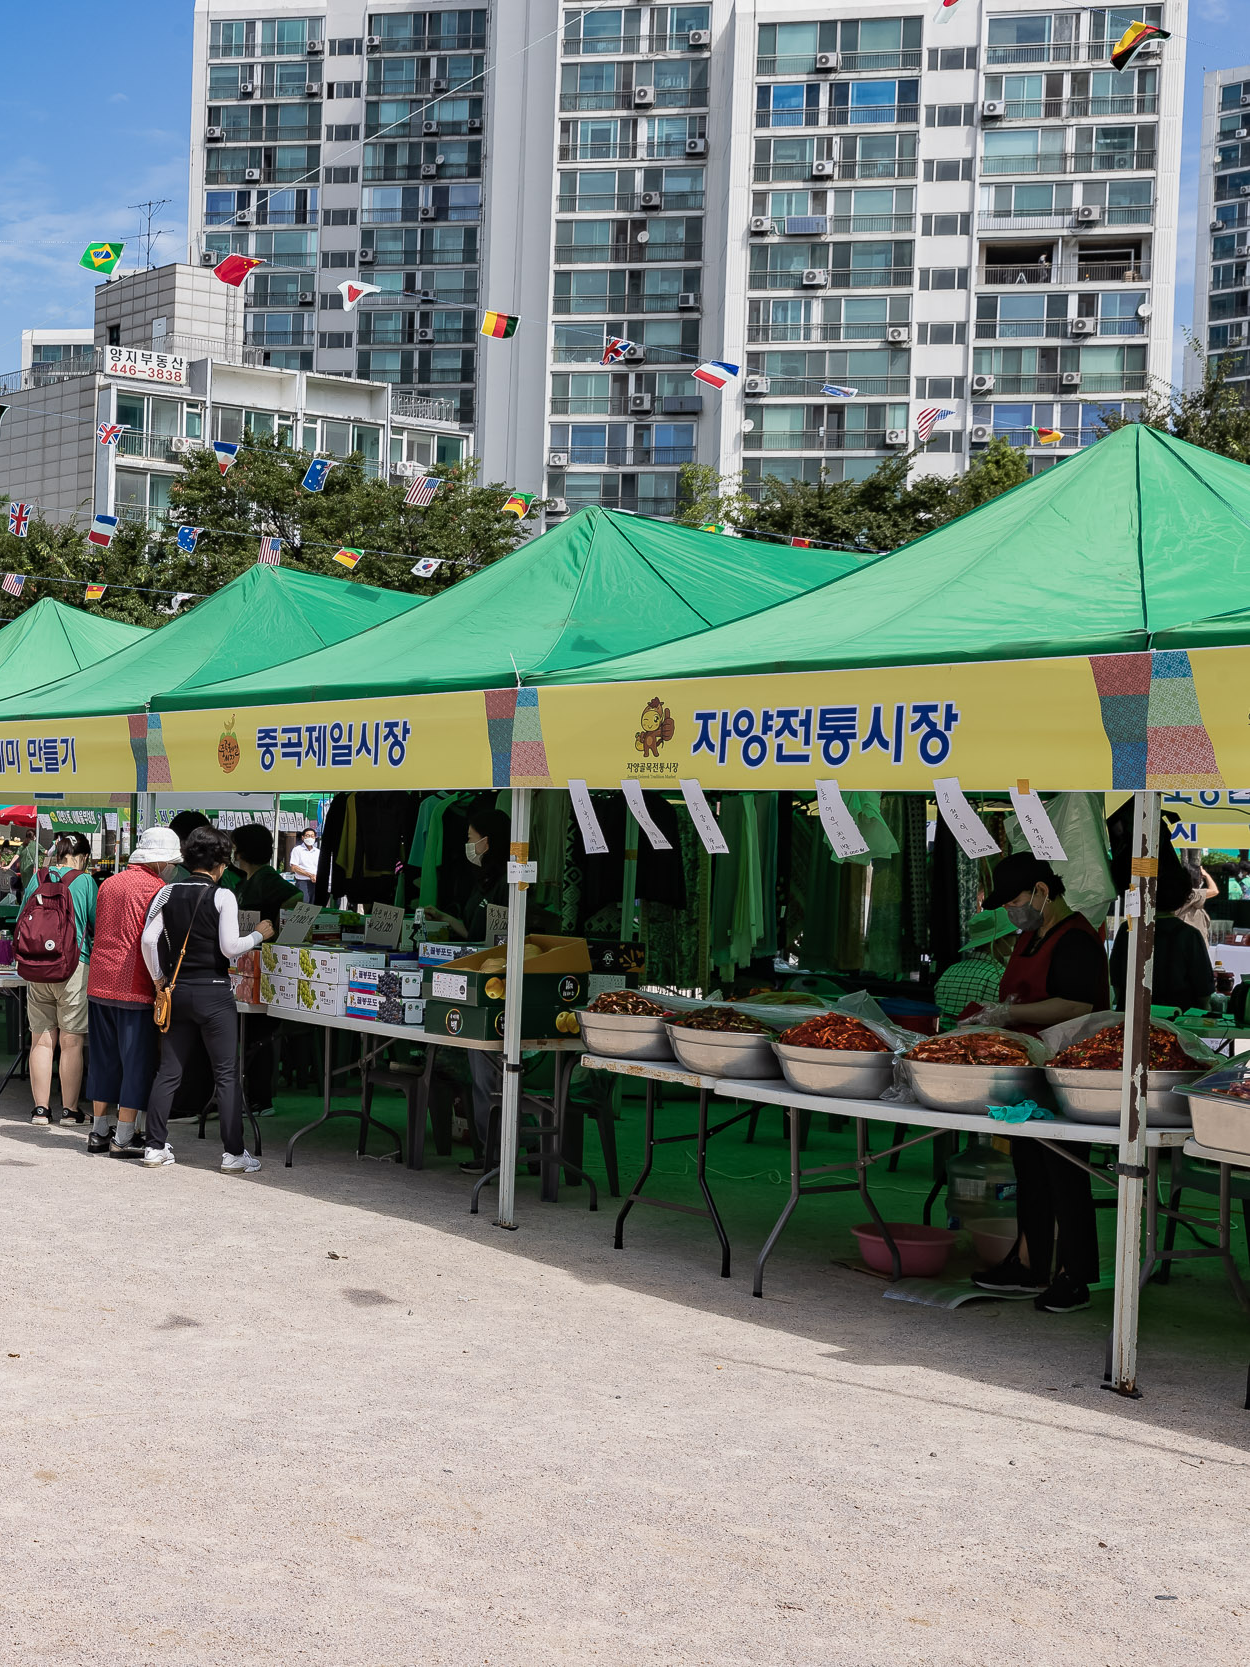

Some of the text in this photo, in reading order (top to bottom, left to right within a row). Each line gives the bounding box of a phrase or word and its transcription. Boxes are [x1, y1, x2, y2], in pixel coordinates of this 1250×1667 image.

[110, 348, 183, 370] 양지부동산
[110, 363, 182, 382] 446-3838
[256, 720, 411, 772] 중곡제일시장
[691, 702, 959, 768] 자양전통시장
[27, 738, 77, 773] 만들기
[626, 762, 679, 773] 자양골목전통시장
